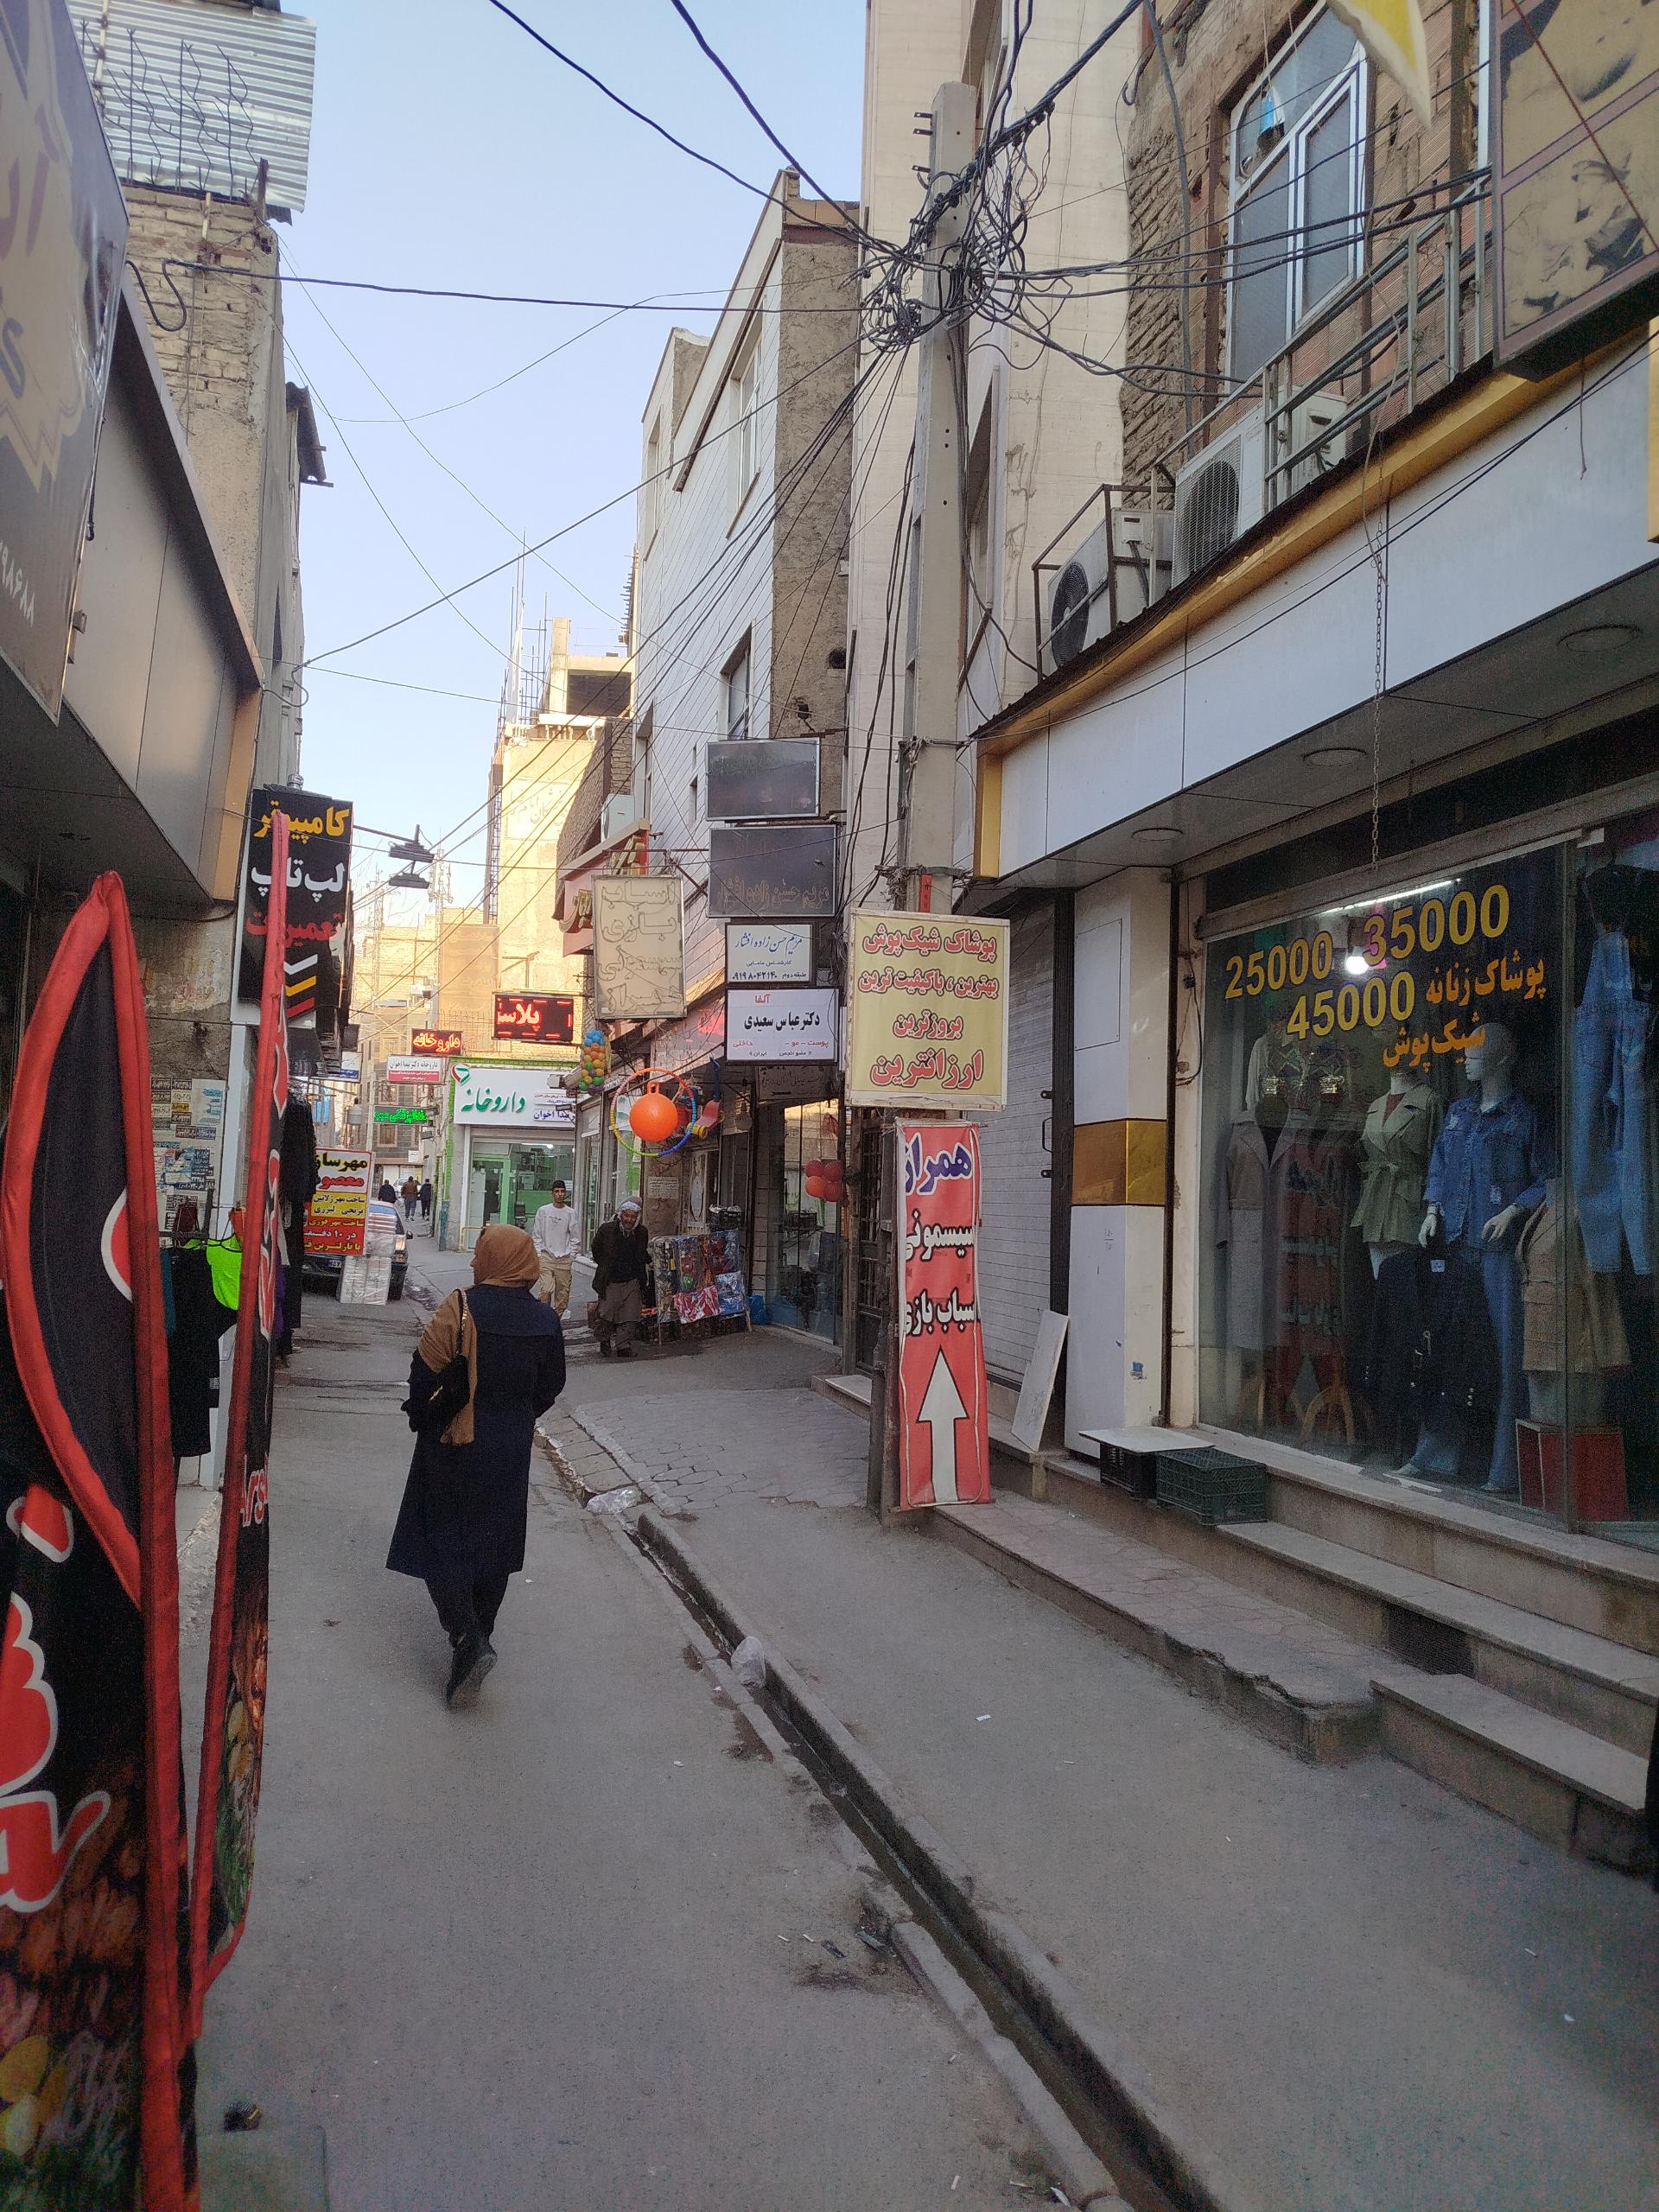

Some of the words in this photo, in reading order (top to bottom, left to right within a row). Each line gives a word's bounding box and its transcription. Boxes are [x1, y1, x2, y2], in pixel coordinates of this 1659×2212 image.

[0, 539, 35, 629] ۹۸۶۸۸
[253, 800, 350, 844] کامپیتر
[304, 862, 346, 903] لپ
[245, 912, 345, 947] تعمیرت
[944, 929, 996, 963] پوشاک
[1224, 931, 1333, 1001] 25000
[1363, 884, 1510, 967] 35000
[1425, 961, 1474, 1005] زنانه
[1474, 949, 1545, 1000] پوشاک
[754, 994, 771, 1004] آلفا
[1287, 971, 1415, 1040] 45000
[744, 1014, 774, 1032] سعیدی
[775, 1011, 800, 1031] عباس
[800, 1011, 820, 1030] دکتر
[807, 1039, 829, 1048] پوست
[461, 1087, 525, 1113] داروخانه
